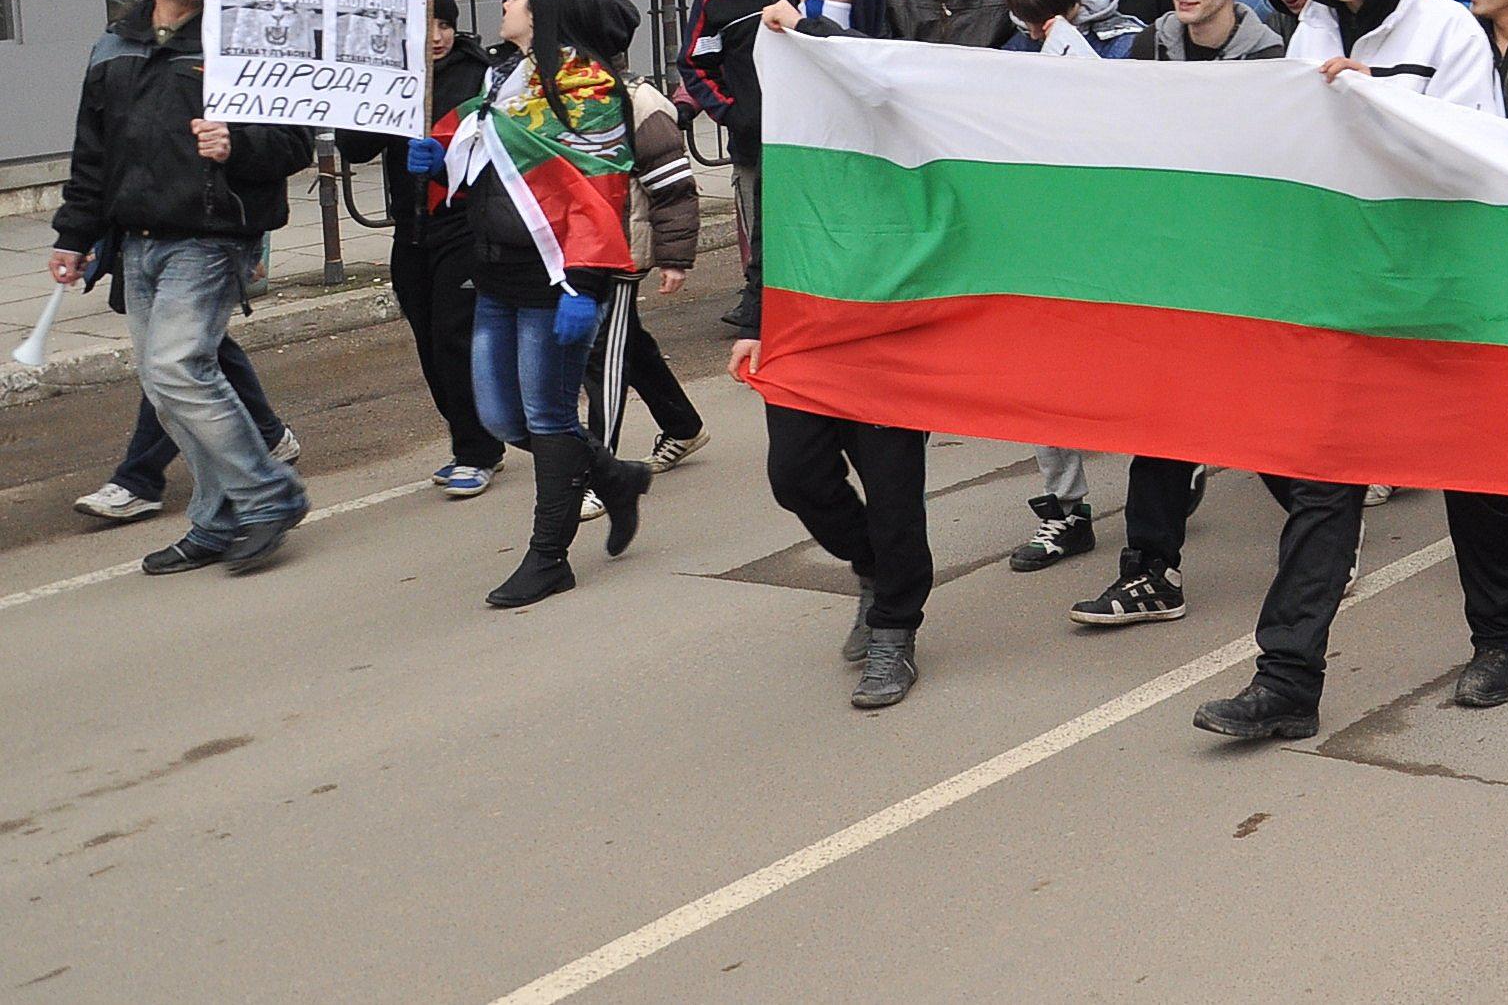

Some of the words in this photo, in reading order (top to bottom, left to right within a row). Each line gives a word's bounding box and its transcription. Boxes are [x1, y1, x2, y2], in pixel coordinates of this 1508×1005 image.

[234, 59, 373, 94] НАРОДА
[385, 76, 419, 99] ГО
[204, 92, 331, 121] НАЛАГА
[354, 101, 416, 130] САМ!
